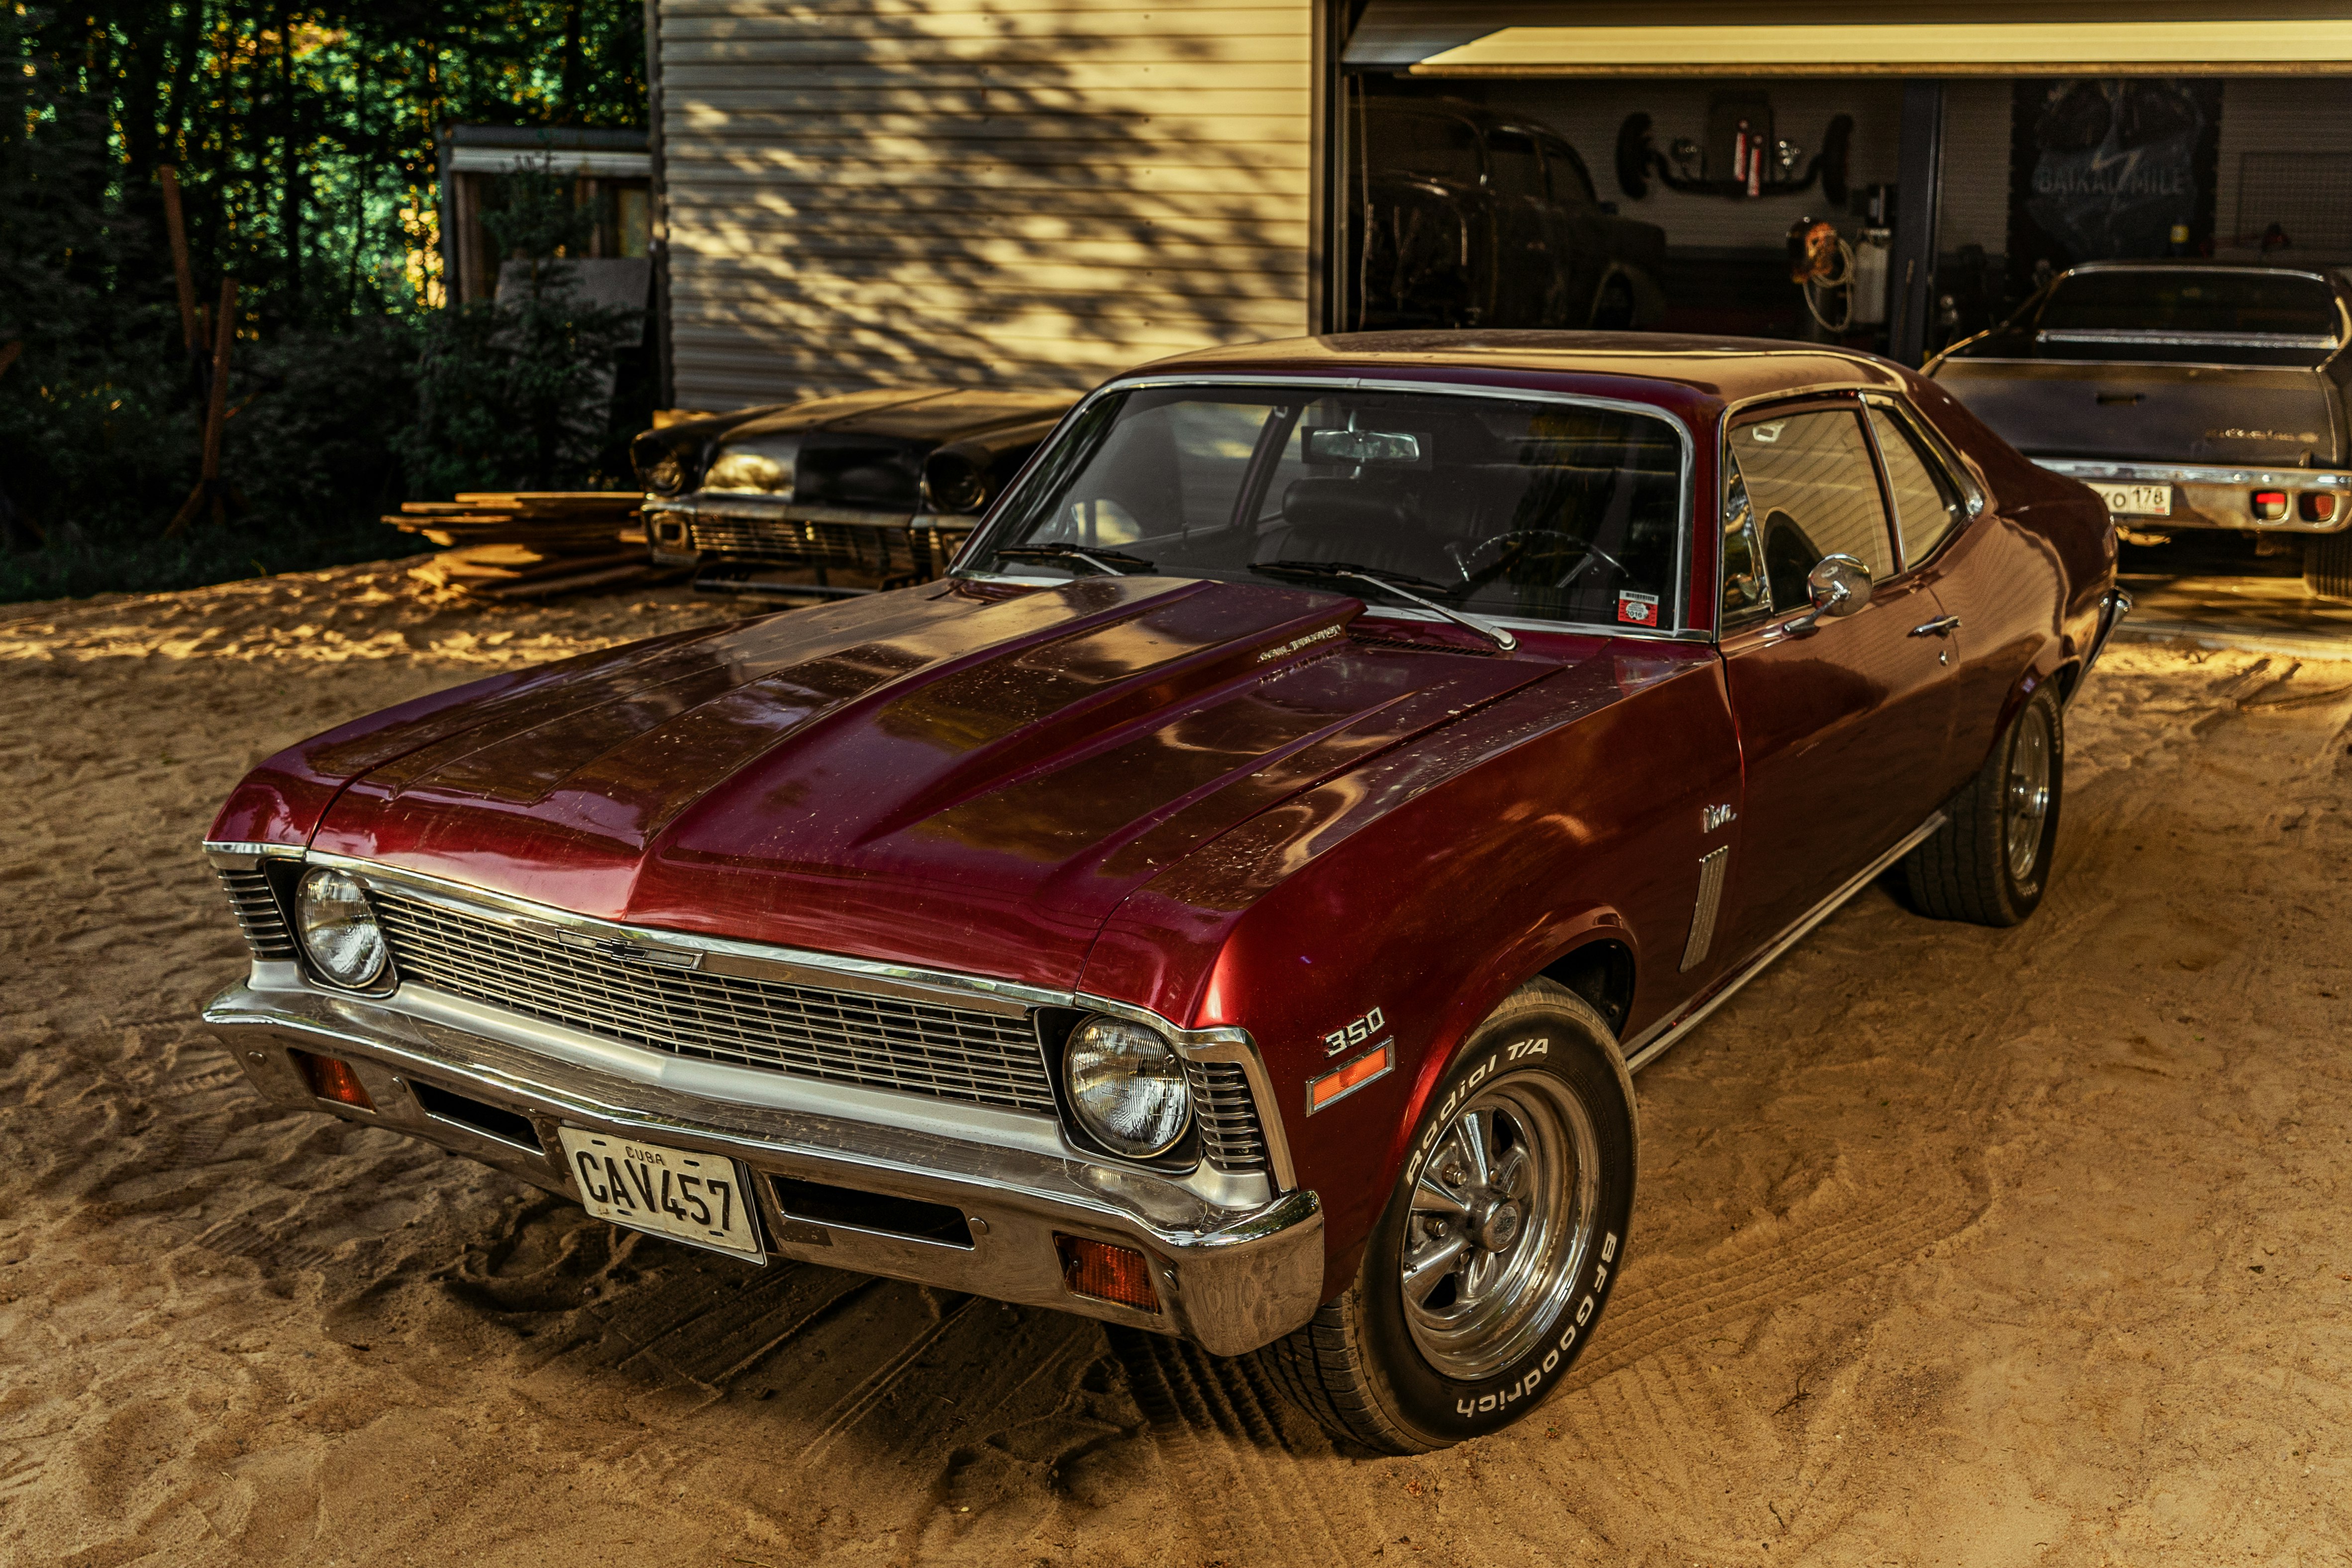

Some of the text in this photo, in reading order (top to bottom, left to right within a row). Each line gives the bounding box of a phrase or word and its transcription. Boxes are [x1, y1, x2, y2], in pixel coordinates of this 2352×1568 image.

[2131, 167, 2185, 195] MILE
[2132, 487, 2164, 505] 178
[1324, 1006, 1384, 1057] 350
[1405, 1054, 1497, 1186] Radial
[1507, 1038, 1549, 1061] T/A
[624, 1146, 666, 1166] CUBA
[576, 1150, 730, 1231] CAV457
